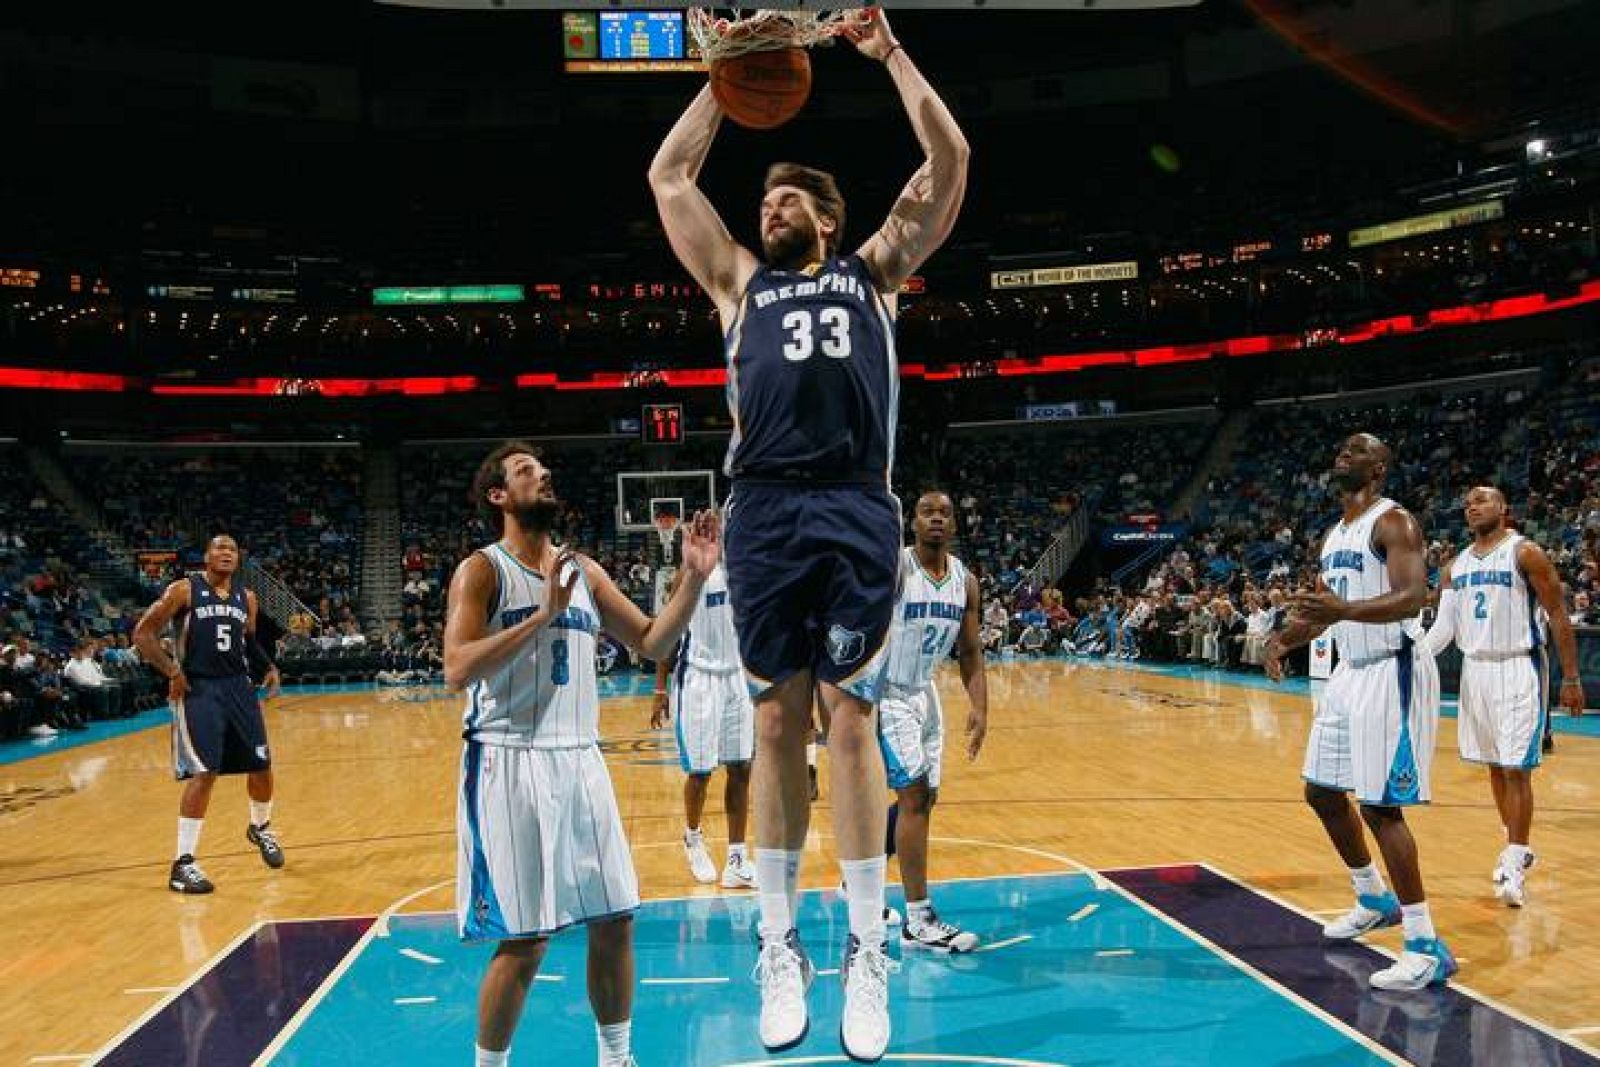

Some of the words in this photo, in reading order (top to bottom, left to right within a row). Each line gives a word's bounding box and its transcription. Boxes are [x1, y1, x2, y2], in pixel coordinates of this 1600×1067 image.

[781, 306, 850, 361] 33
[1475, 591, 1487, 619] 2
[216, 624, 232, 652] 5
[551, 639, 570, 686] 8
